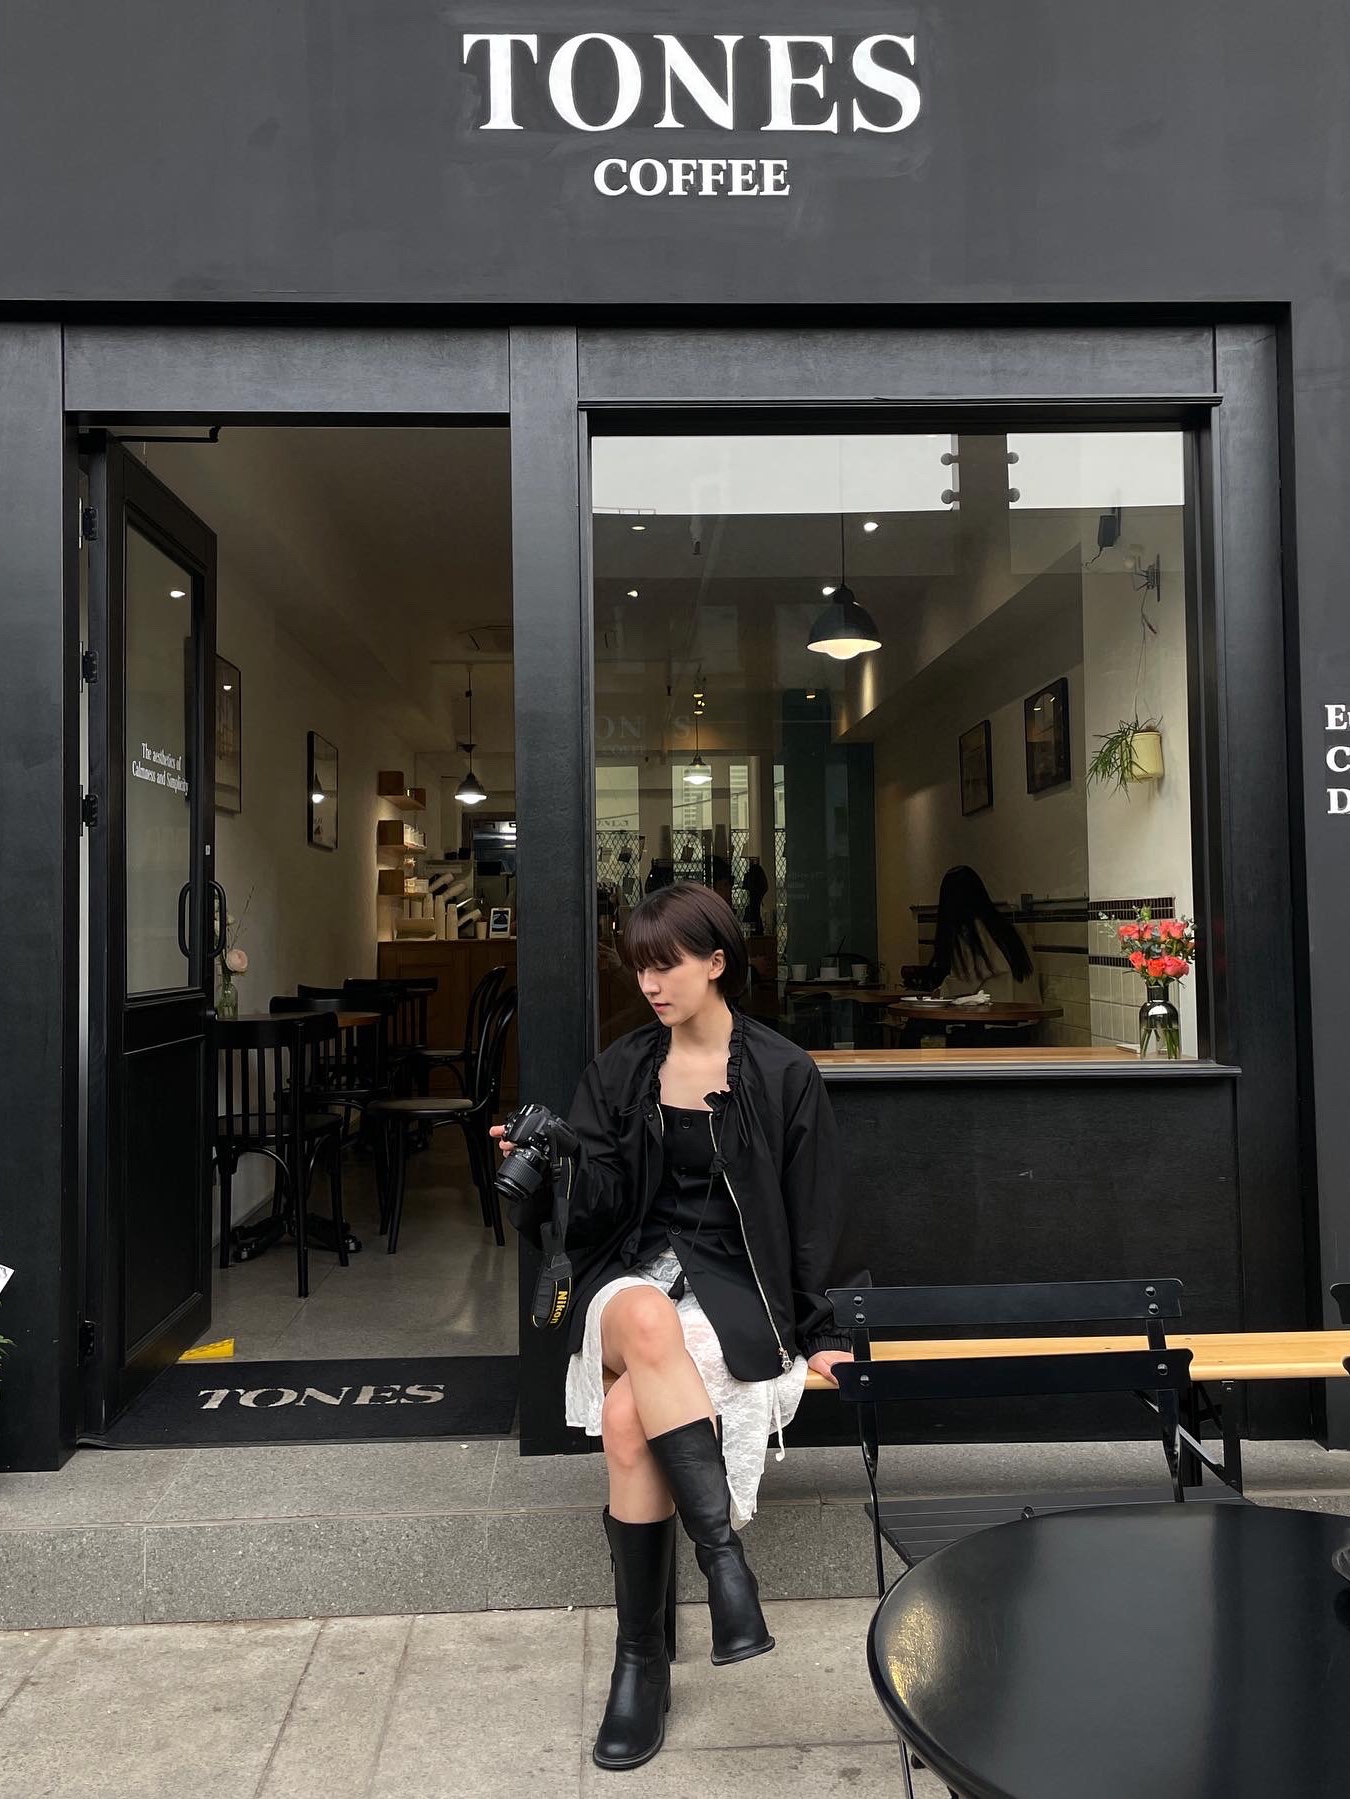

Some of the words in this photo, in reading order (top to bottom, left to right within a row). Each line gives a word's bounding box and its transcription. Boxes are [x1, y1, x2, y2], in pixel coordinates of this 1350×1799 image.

[462, 32, 921, 134] TONES
[593, 158, 790, 197] COFFEE
[1324, 704, 1350, 730] E
[141, 742, 152, 761] The
[156, 770, 166, 786] and
[550, 1290, 568, 1324] Nikon
[197, 1384, 446, 1410] TONES
